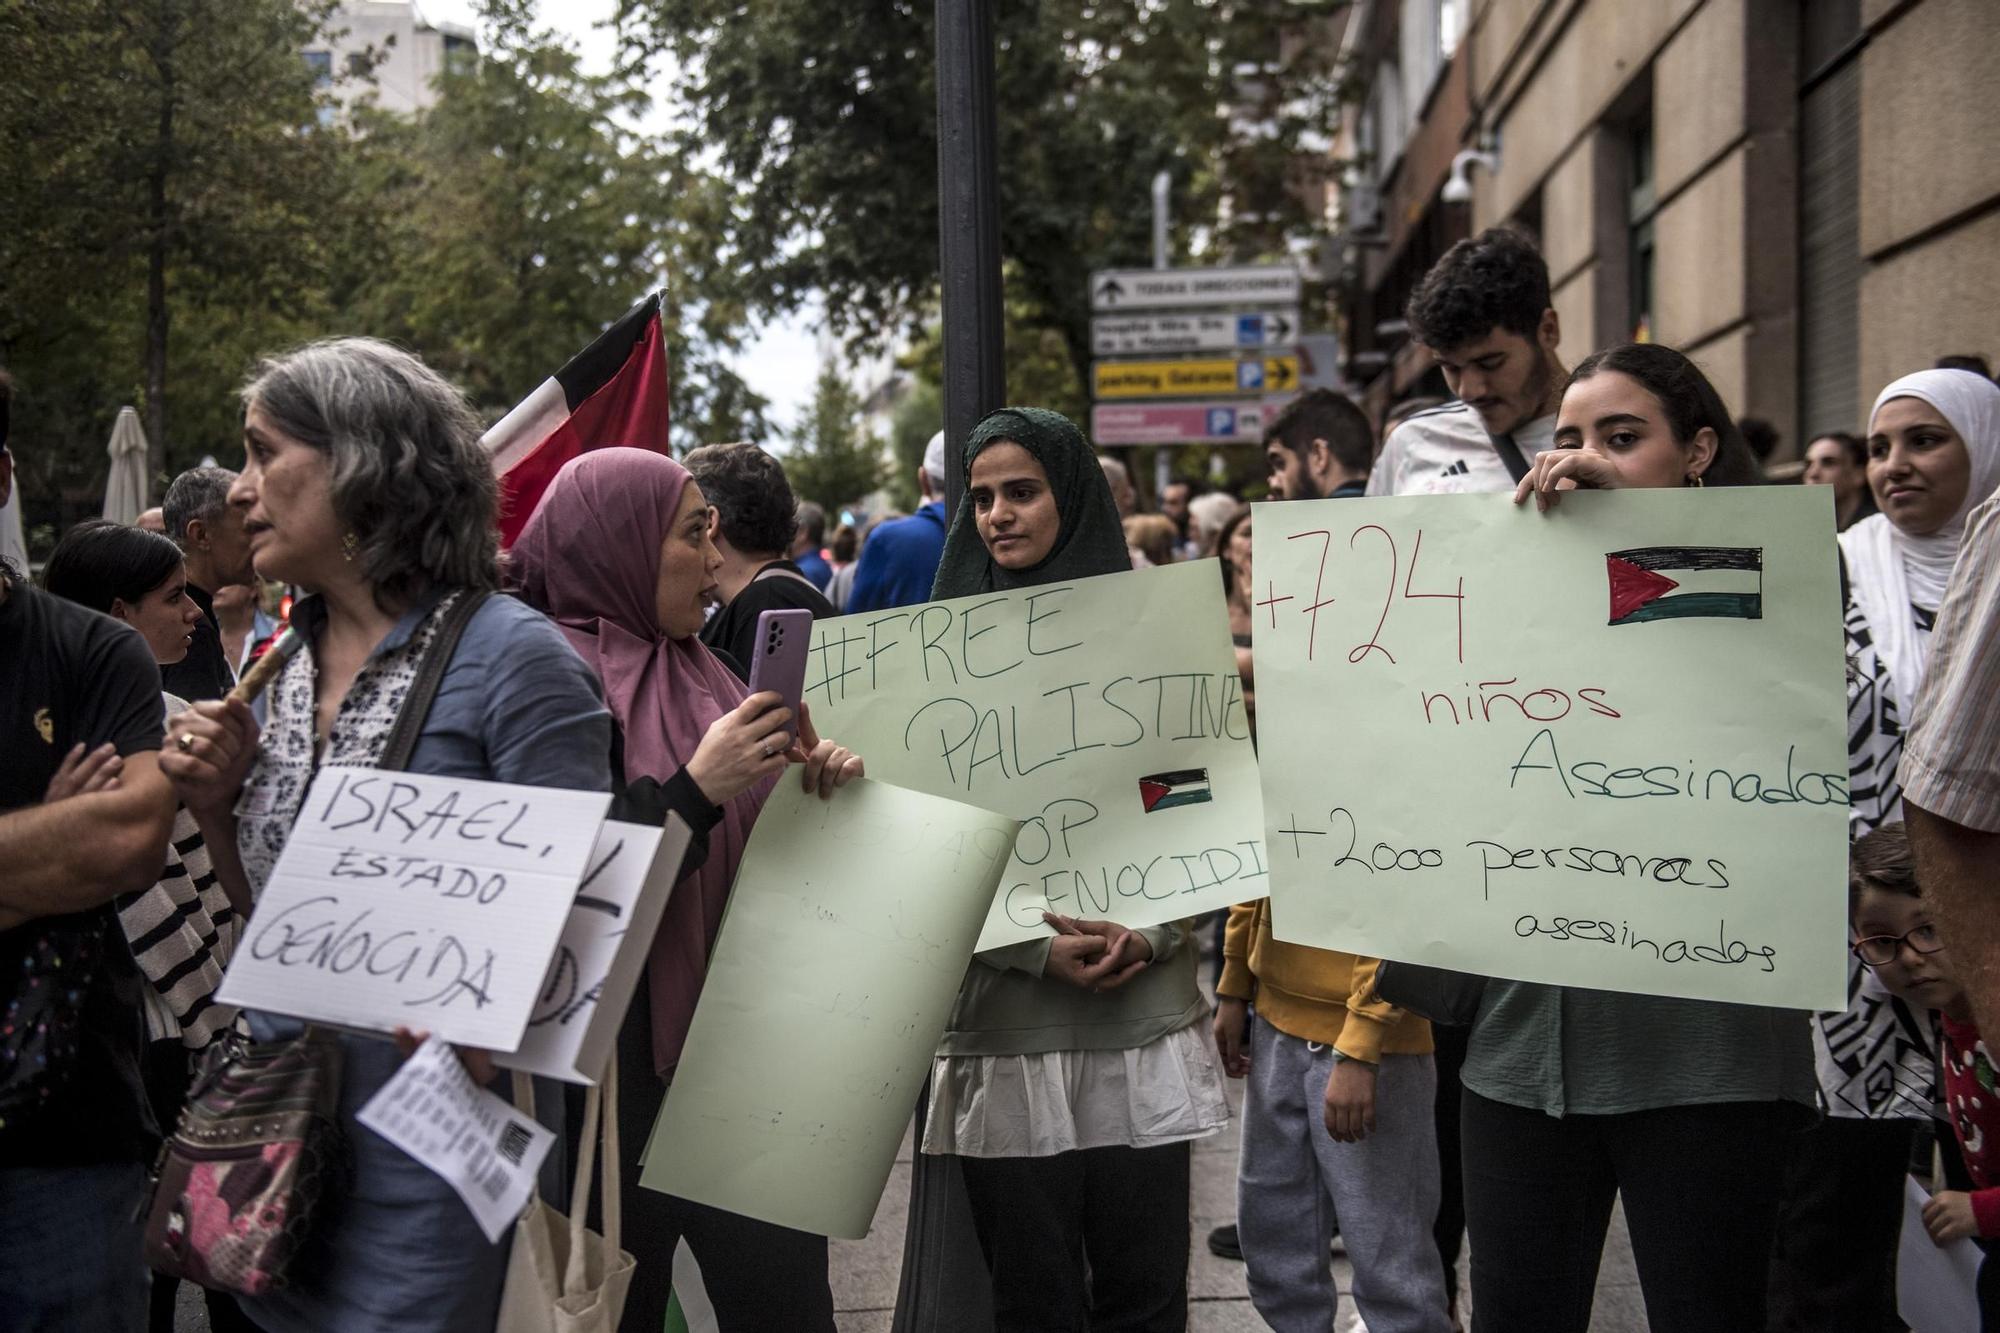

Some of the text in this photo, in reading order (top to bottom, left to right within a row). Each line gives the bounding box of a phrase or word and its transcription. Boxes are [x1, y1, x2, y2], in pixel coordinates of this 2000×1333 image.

[1255, 524, 1465, 665] +724
[805, 587, 1084, 706] #FREE
[904, 673, 1249, 791] PALISTINE
[1420, 676, 1622, 726] niños
[1510, 728, 1850, 806] Asesinados
[321, 774, 554, 858] ISRAEL,
[1014, 798, 1100, 866] OP
[330, 848, 507, 905] ESTADO
[1005, 840, 1269, 928] GENOCIDI
[1466, 841, 1730, 902] personas
[1514, 914, 1777, 973] asesinados
